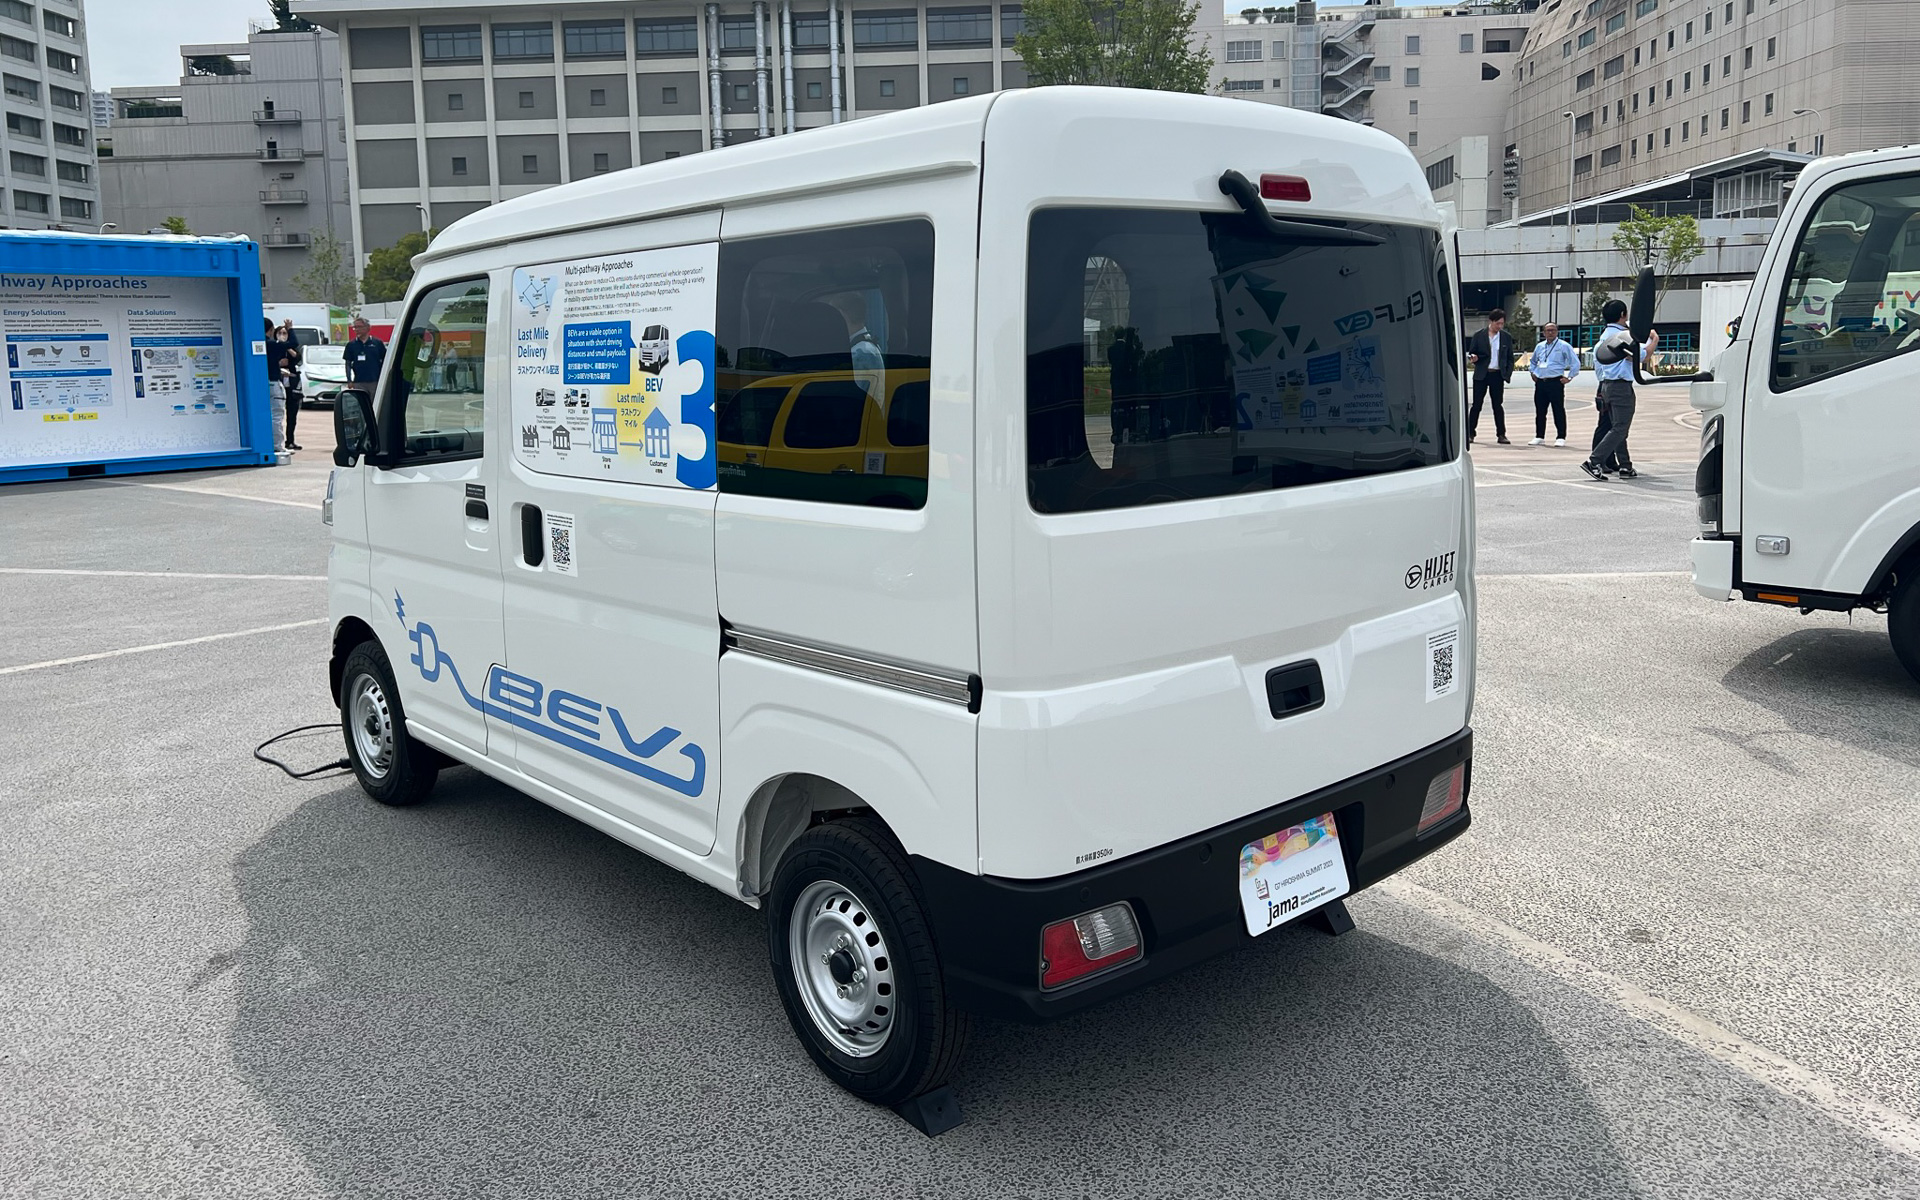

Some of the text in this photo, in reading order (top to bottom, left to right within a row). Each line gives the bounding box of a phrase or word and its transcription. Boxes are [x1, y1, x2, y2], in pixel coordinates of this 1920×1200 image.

[565, 260, 633, 276] Multi-pathway Approaches
[1, 275, 148, 291] hway Approaches
[3, 309, 29, 317] Energy
[518, 327, 549, 341] Last Mile
[603, 327, 617, 337] option
[518, 345, 547, 361] Delivery
[587, 349, 595, 357] and
[607, 348, 626, 358] payloads
[645, 377, 663, 392] BEV
[617, 393, 645, 403] Last mile
[621, 408, 641, 416] ラストワン
[1424, 551, 1455, 581] HIJET
[1423, 573, 1453, 590] CARGO
[489, 666, 682, 758] BEV
[1281, 872, 1305, 887] HIROSHIMA
[1306, 863, 1322, 877] SUMMIT
[1323, 859, 1333, 869] 2023
[1267, 895, 1299, 927] jama
